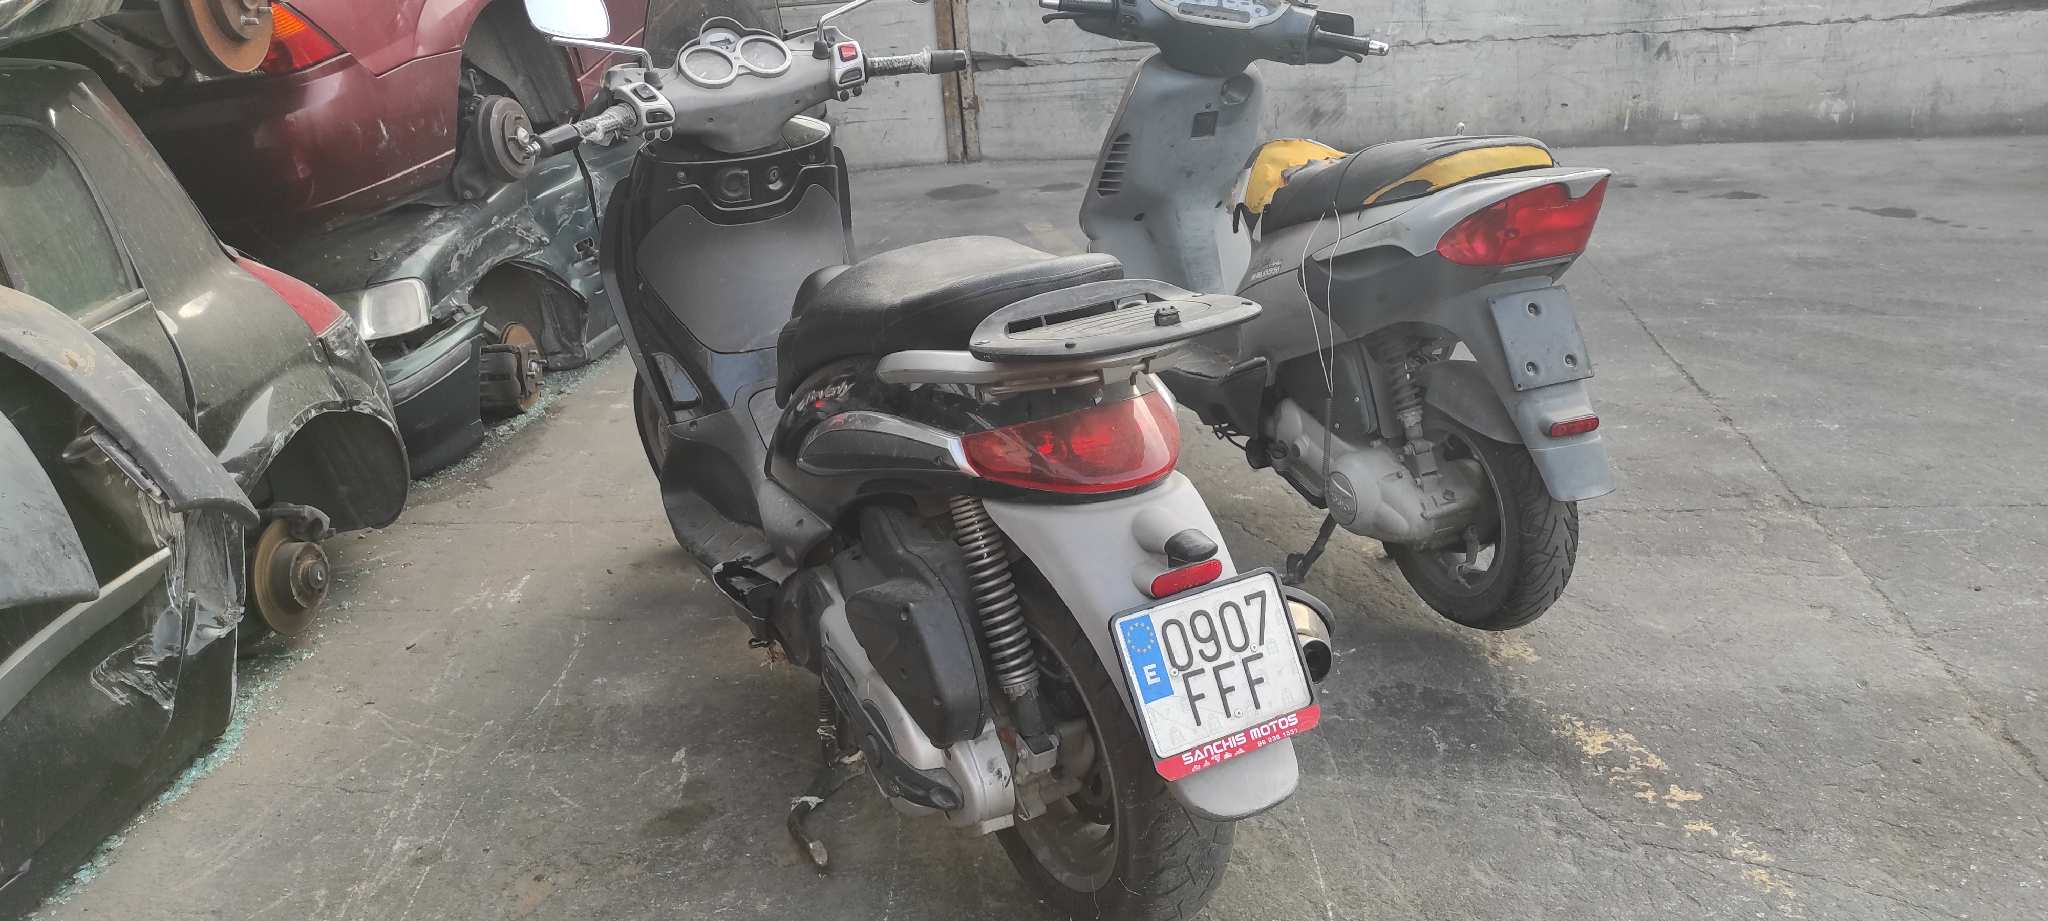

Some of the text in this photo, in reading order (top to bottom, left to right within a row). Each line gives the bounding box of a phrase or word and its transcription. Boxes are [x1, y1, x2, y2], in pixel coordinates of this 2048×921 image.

[1161, 590, 1267, 671] 0907
[1142, 663, 1161, 685] E
[1182, 652, 1265, 727] FFF
[1181, 713, 1298, 765] SANCHIS MOTOS
